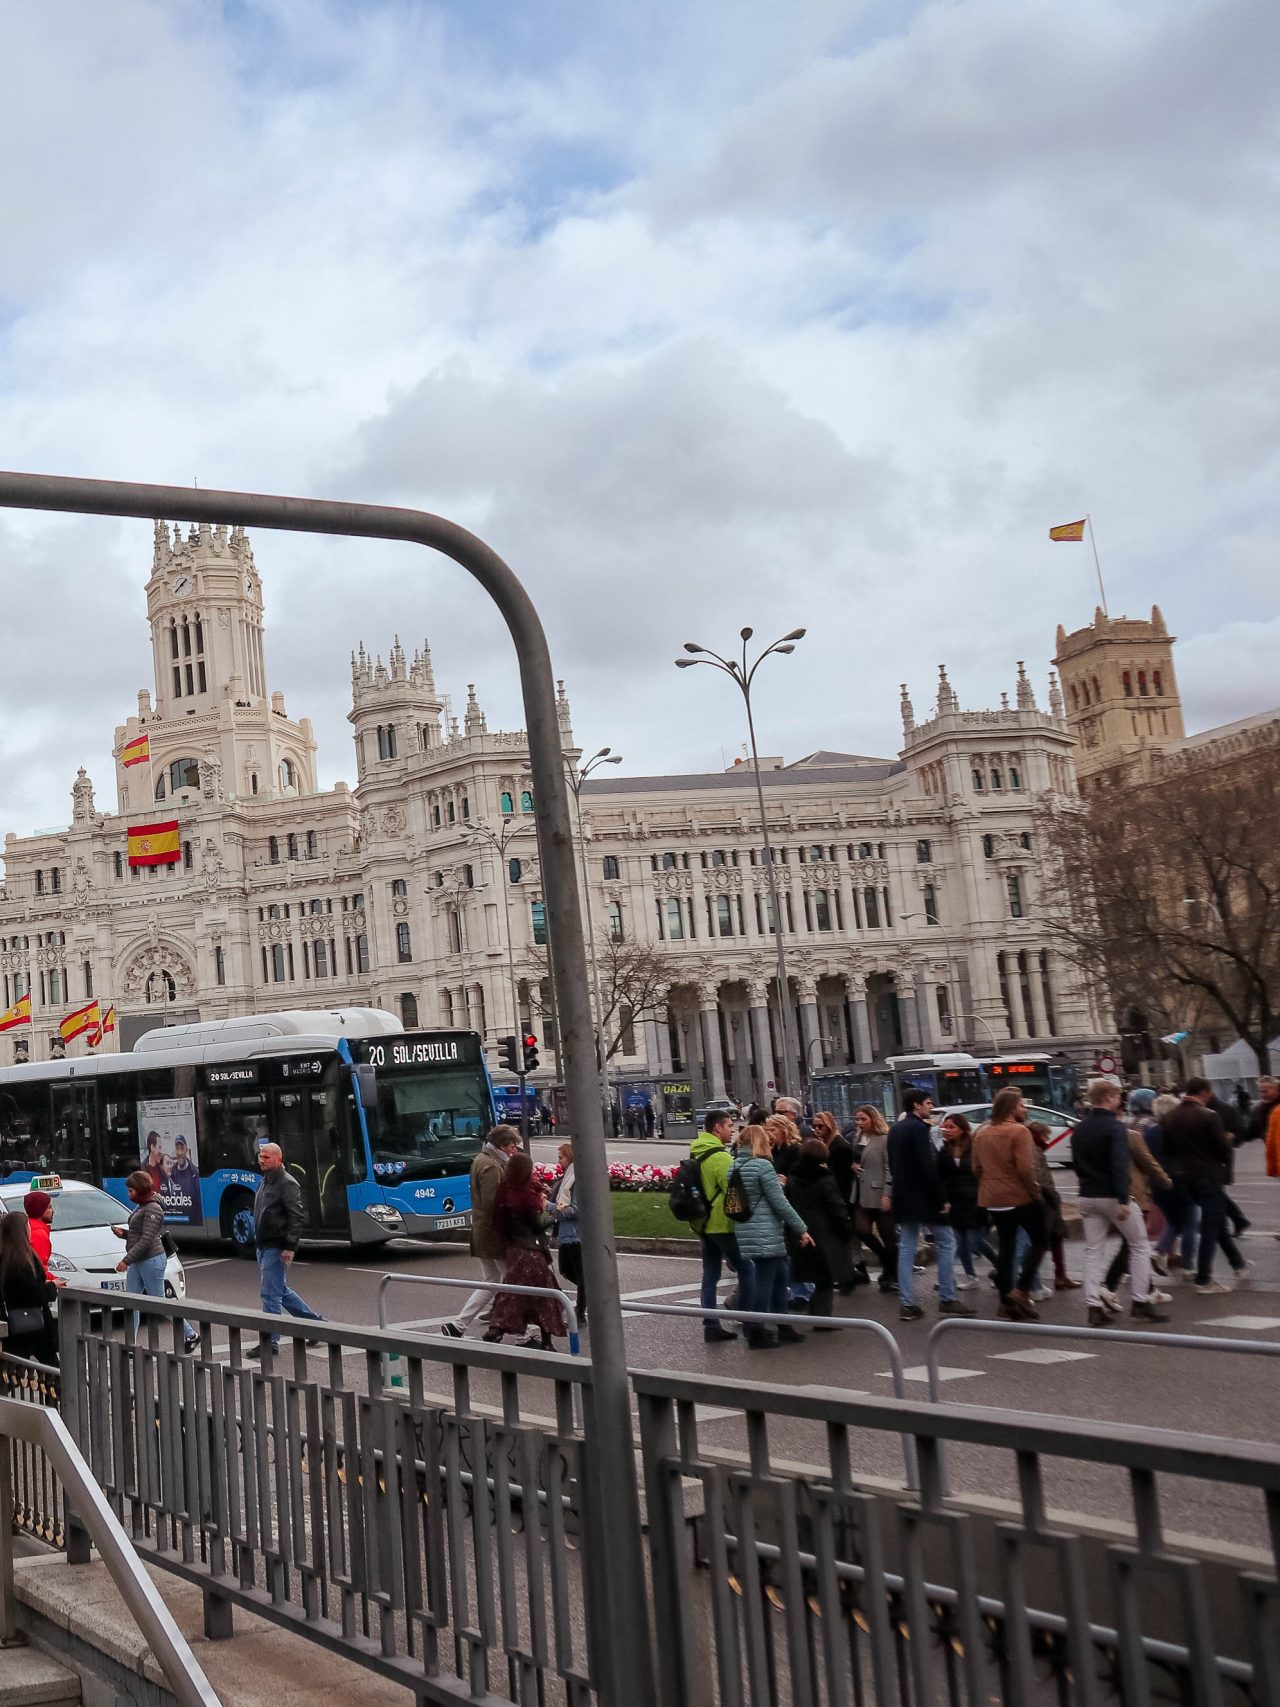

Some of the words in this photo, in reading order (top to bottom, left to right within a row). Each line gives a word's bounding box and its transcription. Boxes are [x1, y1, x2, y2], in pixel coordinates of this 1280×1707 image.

[369, 1046, 385, 1066] 20
[393, 1042, 458, 1064] SOL/SEVILLA
[210, 1073, 220, 1081] 20
[220, 1070, 254, 1080] SOL/SEVILLA
[663, 1085, 690, 1094] DAZN
[240, 1173, 256, 1183] 4942
[414, 1188, 435, 1198] 4942
